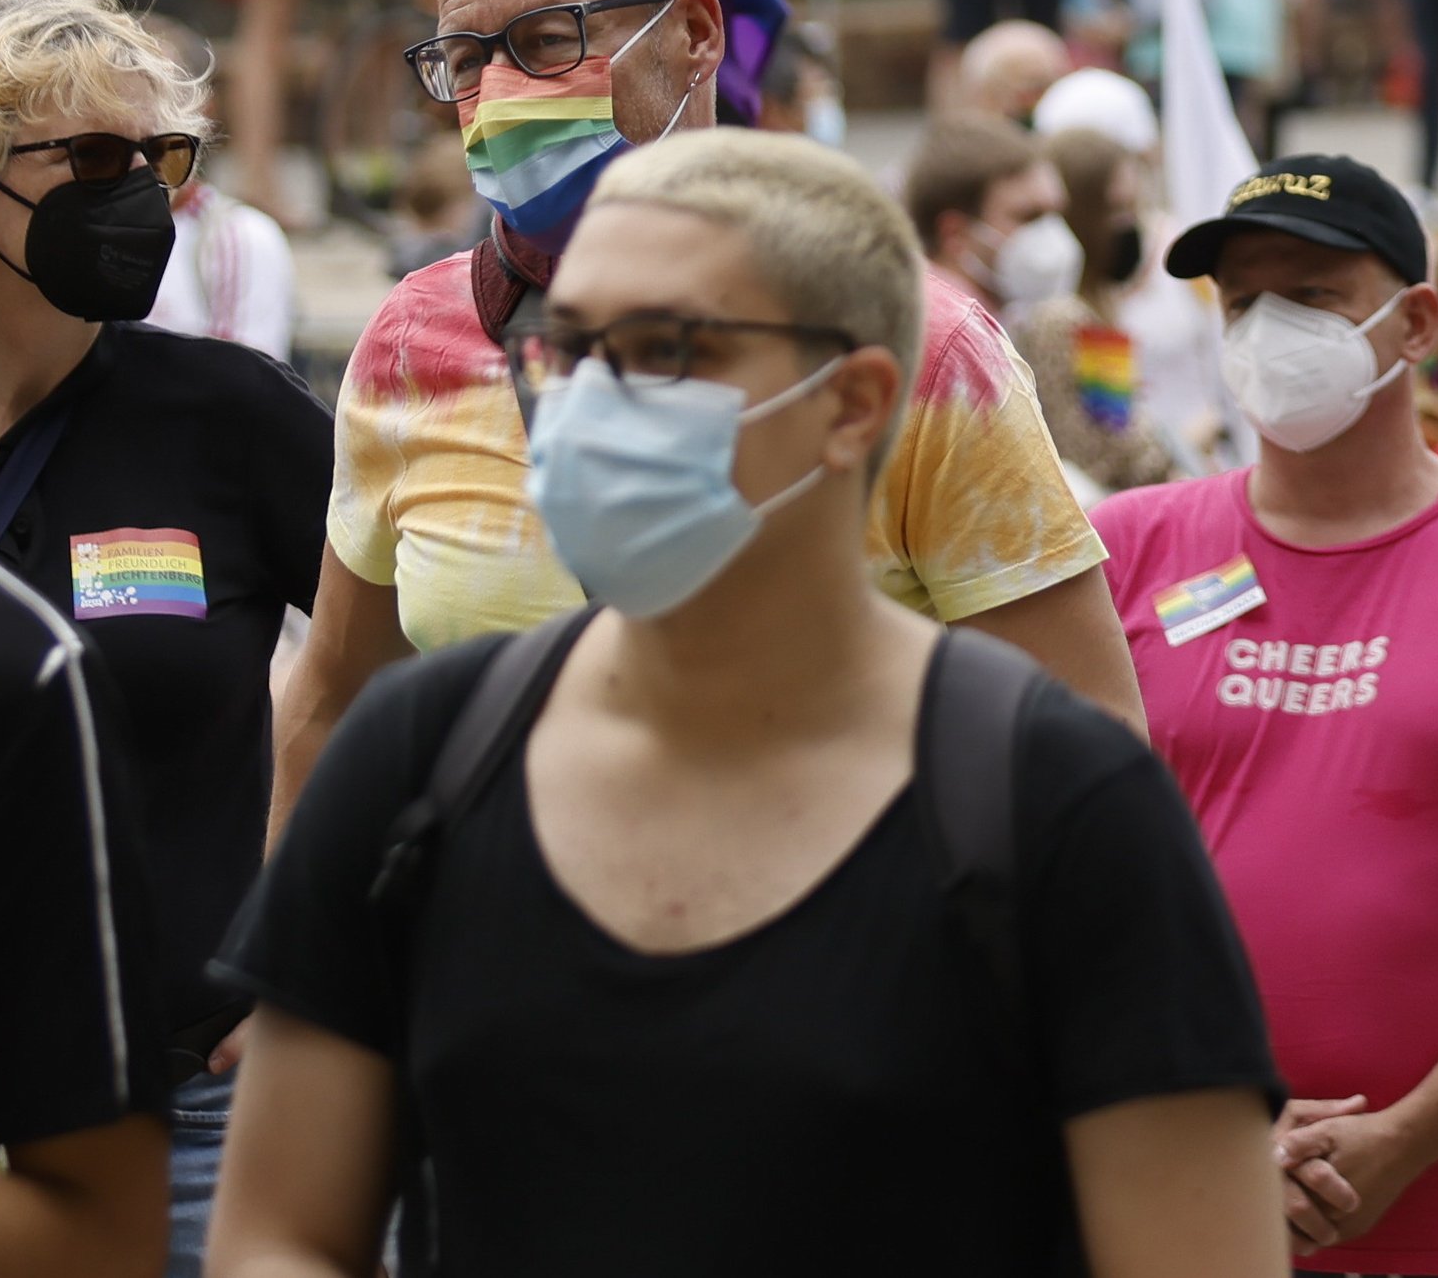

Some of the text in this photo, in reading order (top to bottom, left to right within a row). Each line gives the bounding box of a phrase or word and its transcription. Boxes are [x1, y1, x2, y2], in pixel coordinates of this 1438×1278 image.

[107, 546, 164, 558] FAMILIEN
[108, 557, 187, 571] FREUNDLICH
[109, 570, 202, 585] LICHTENBERG
[1225, 636, 1390, 677] CHEERS
[1215, 672, 1380, 715] QUEERS
